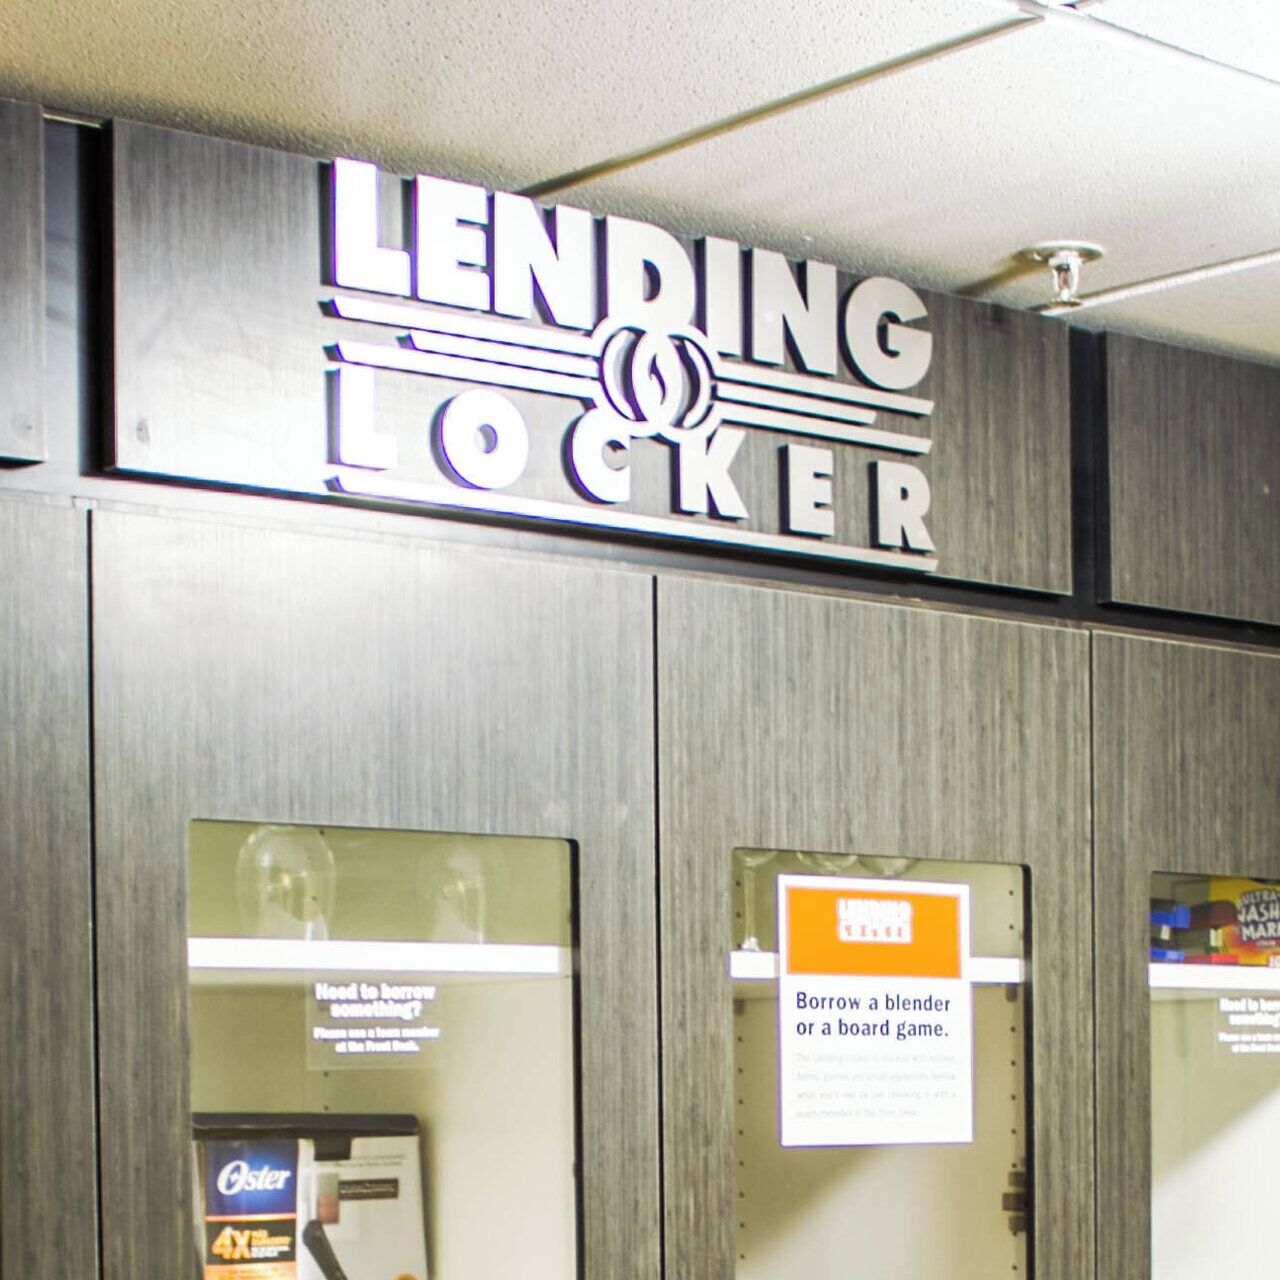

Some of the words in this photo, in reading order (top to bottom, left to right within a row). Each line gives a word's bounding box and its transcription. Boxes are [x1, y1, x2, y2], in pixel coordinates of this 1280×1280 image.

[326, 156, 933, 391] LENDING
[330, 367, 935, 552] LOCKER
[315, 982, 358, 1001] Need
[359, 982, 380, 1001] to
[380, 982, 436, 1001] borrow
[796, 991, 861, 1010] Borrow
[868, 997, 879, 1011] a
[885, 993, 951, 1012] blender
[330, 1000, 422, 1021] something?
[796, 1021, 815, 1036] or
[821, 1022, 832, 1036] a
[838, 1018, 890, 1036] board
[896, 1020, 949, 1041] game.
[216, 1159, 293, 1197] Oster
[211, 1226, 253, 1260] 4X
